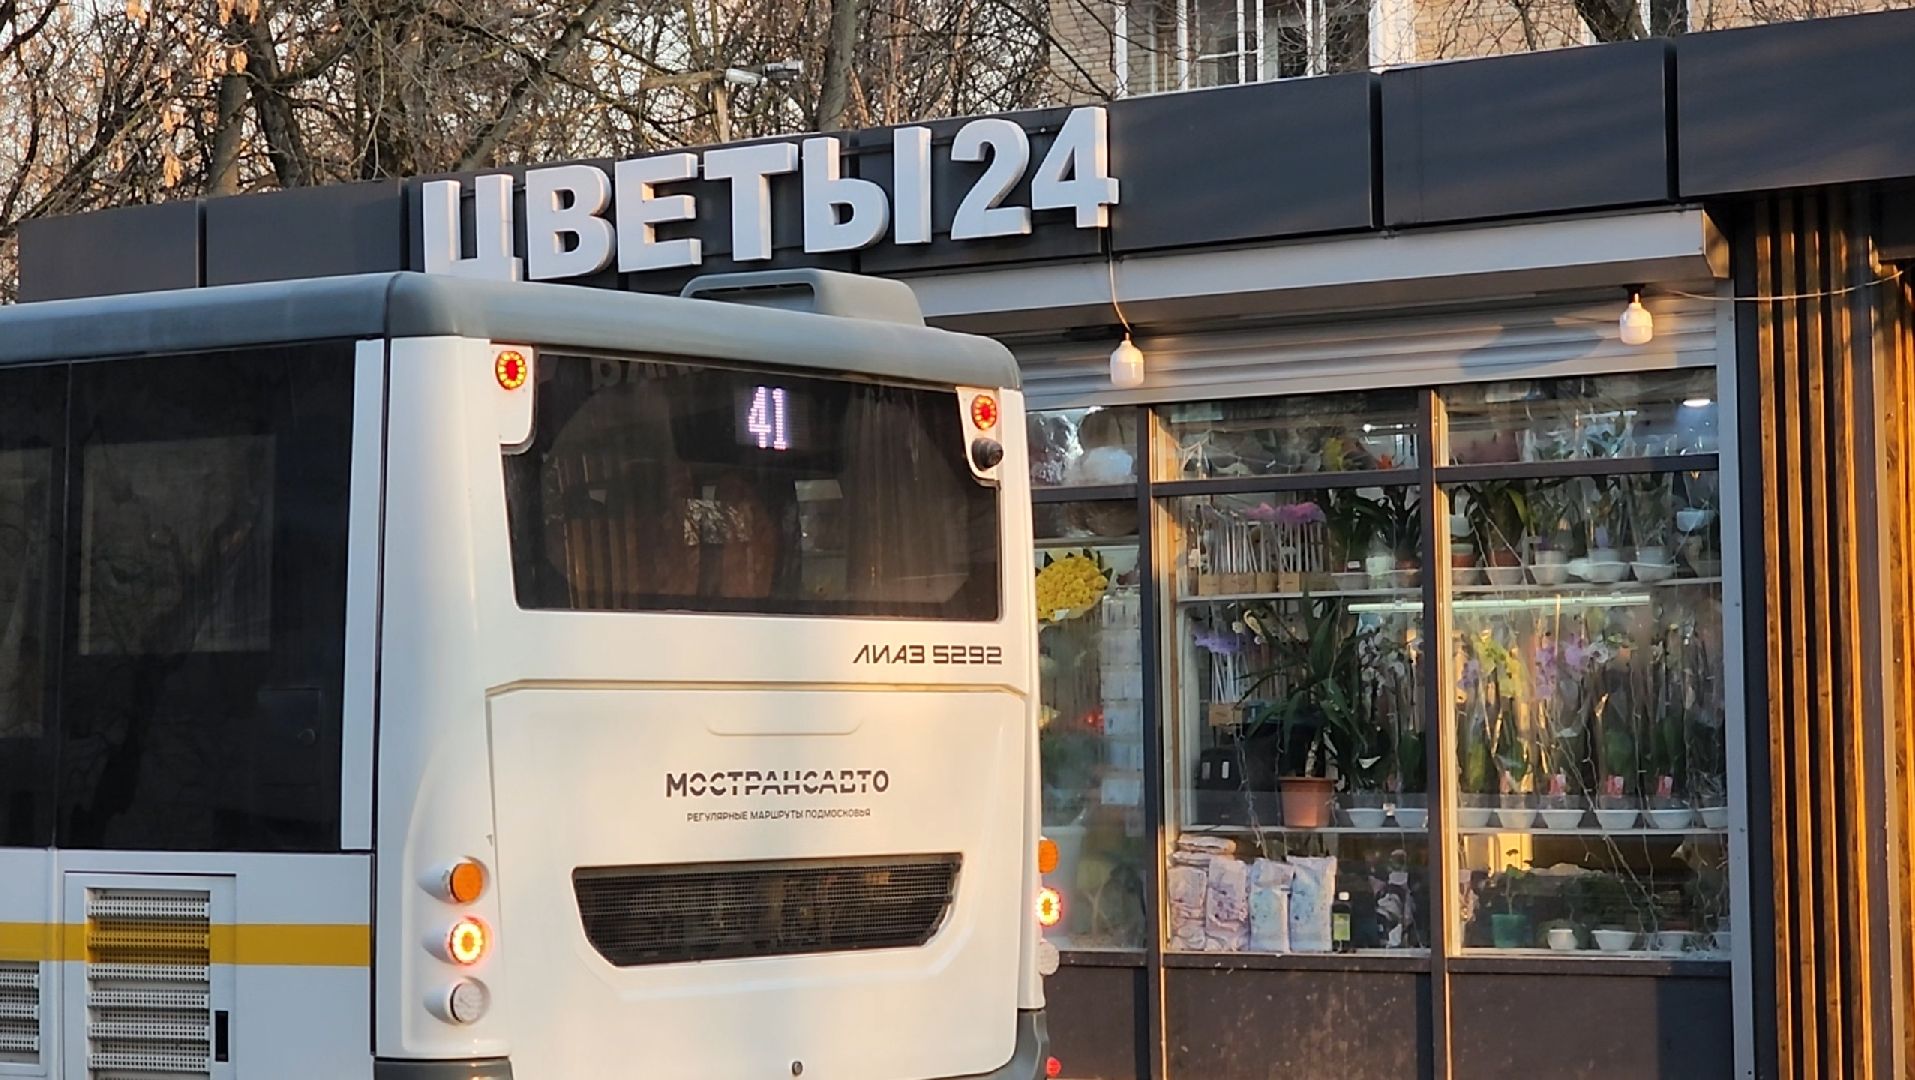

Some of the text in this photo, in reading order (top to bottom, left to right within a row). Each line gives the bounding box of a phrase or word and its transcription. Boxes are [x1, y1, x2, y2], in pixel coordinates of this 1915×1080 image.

[748, 386, 787, 450] 41
[853, 644, 1003, 665] ЛИАЗ 5292
[666, 770, 889, 798] МОСТРАНСАВТО
[687, 807, 871, 822] РЕГУЛЯРНЫЕ МАРШРУТЫ ПОДМОСКОВЬЯ
